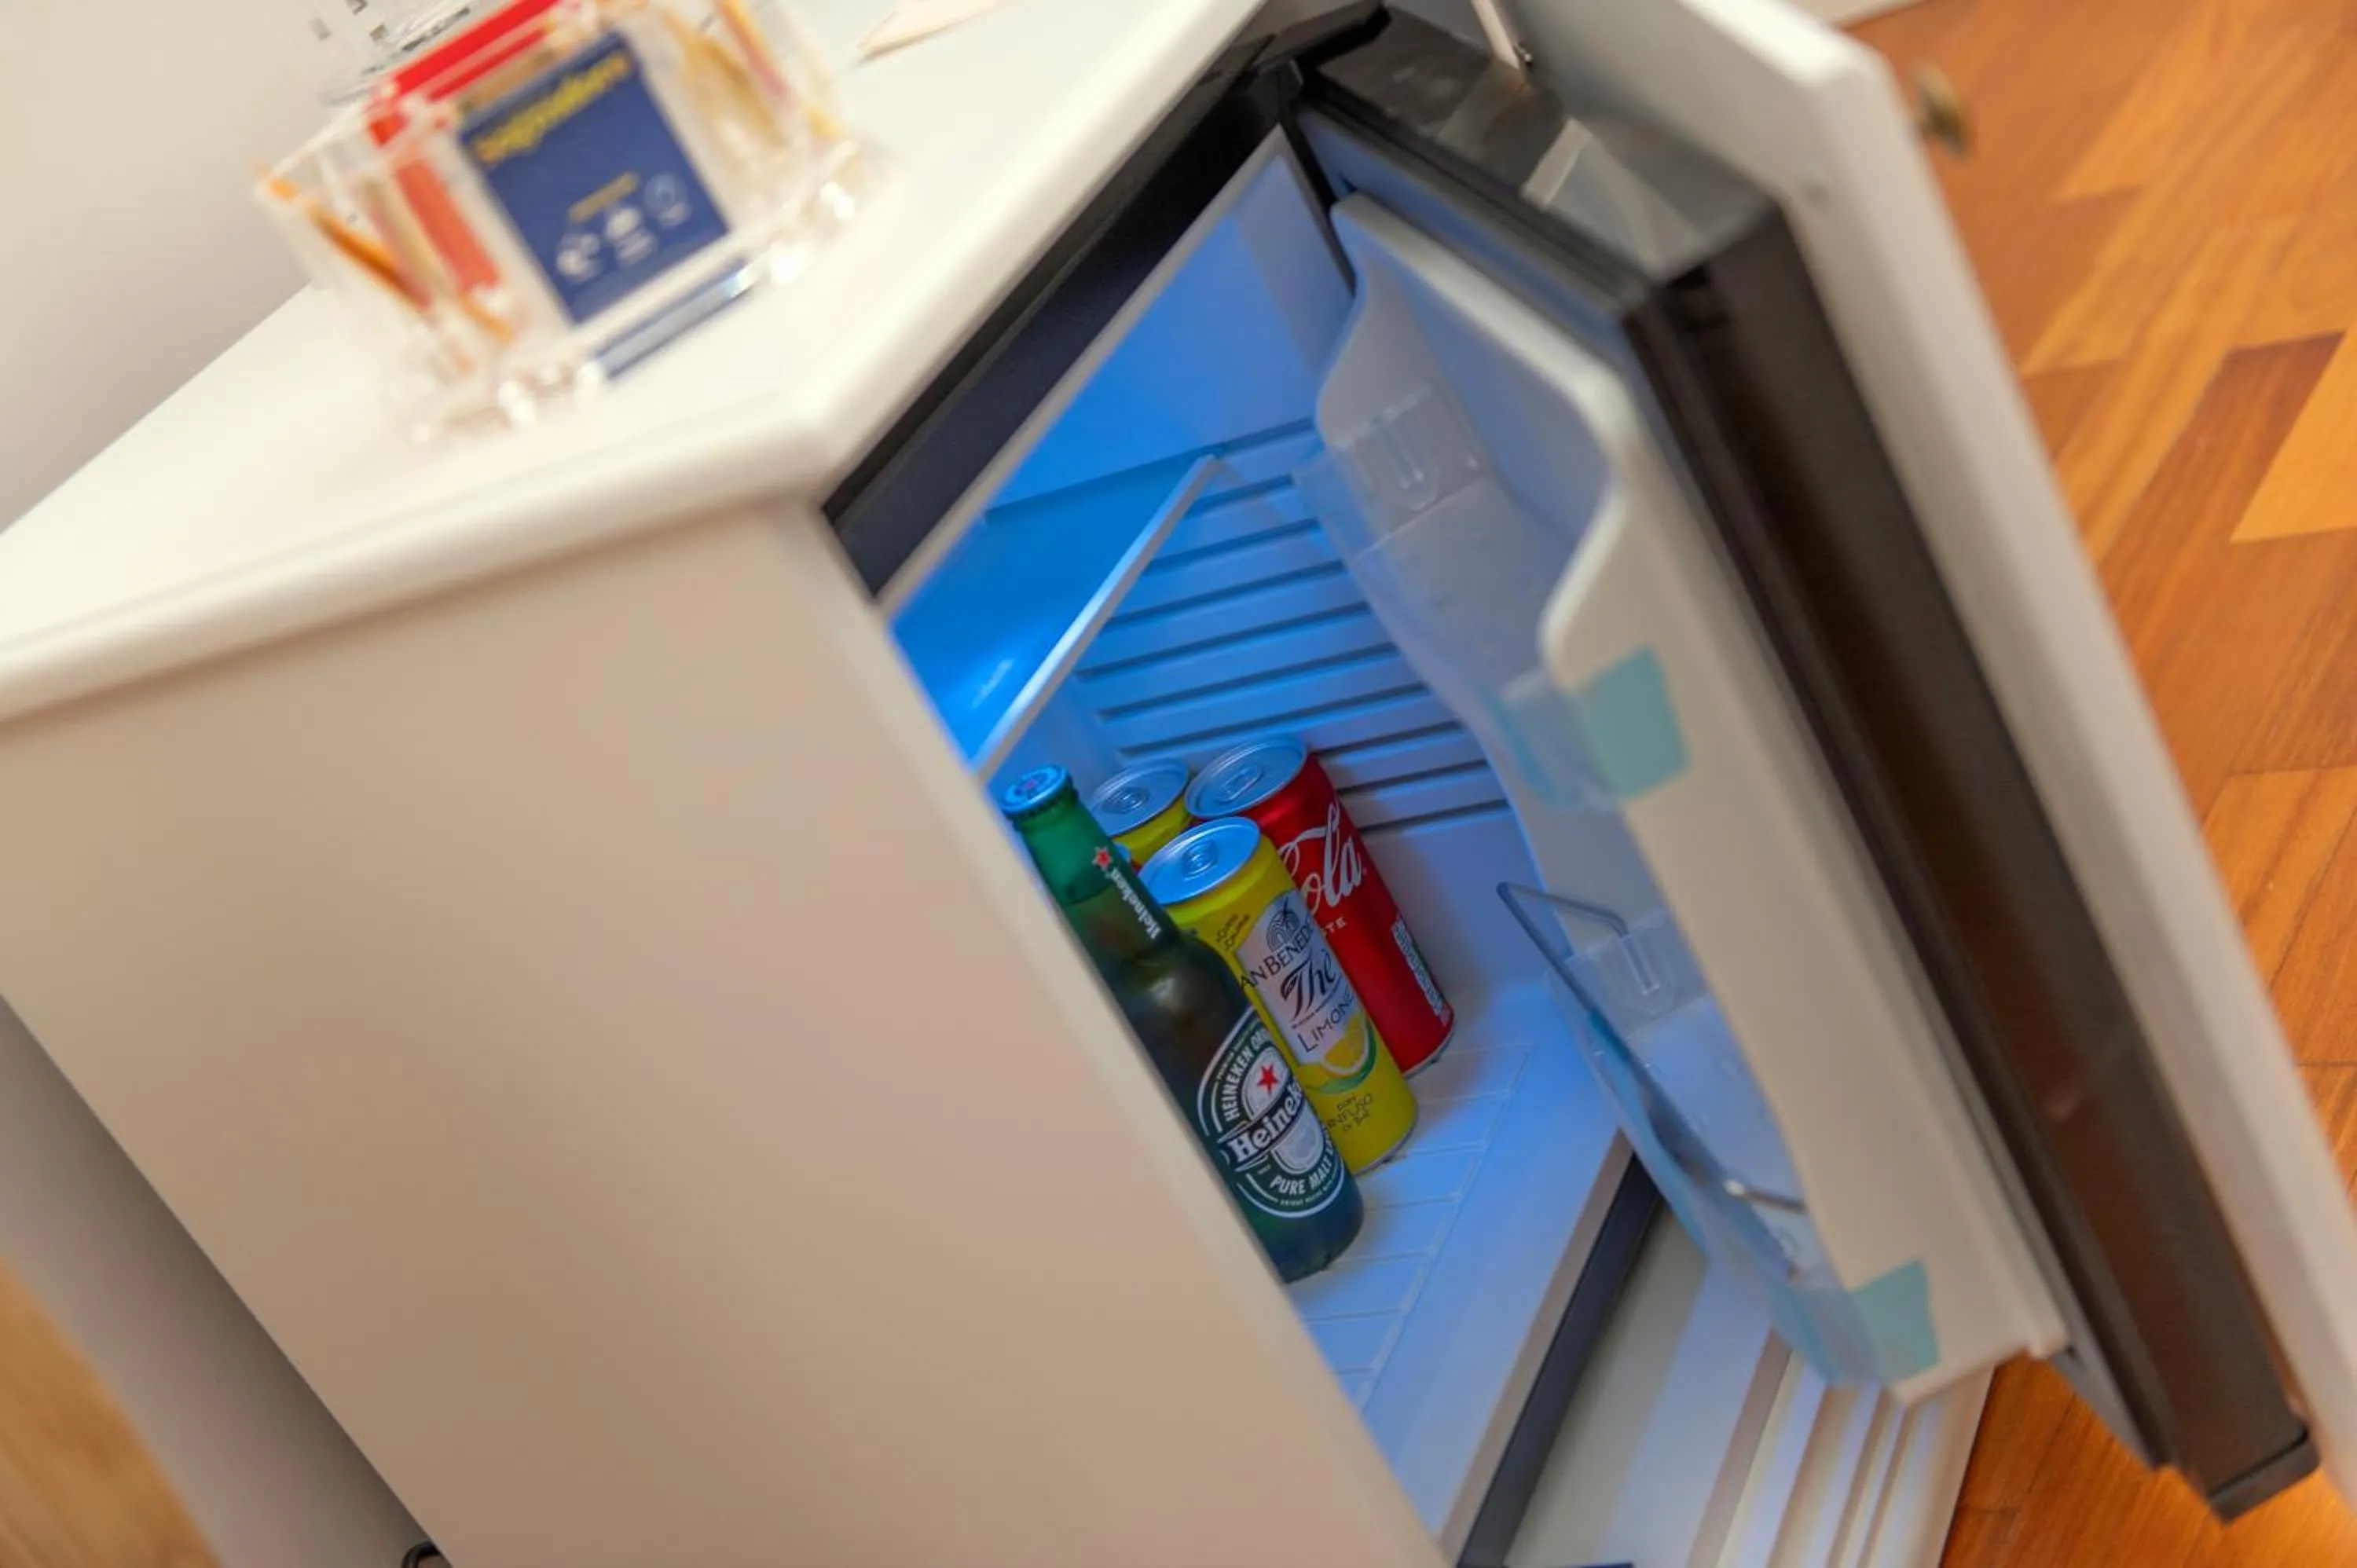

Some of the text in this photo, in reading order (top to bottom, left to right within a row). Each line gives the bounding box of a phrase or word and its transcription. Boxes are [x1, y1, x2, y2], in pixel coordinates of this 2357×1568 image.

[1109, 867, 1161, 939] Heineken
[1241, 965, 1267, 988] AN
[1221, 1046, 1255, 1122] HEINEKEN
[1226, 1080, 1303, 1163] Heinek
[1270, 1175, 1307, 1196] PURE
[1308, 1156, 1332, 1189] MALT
